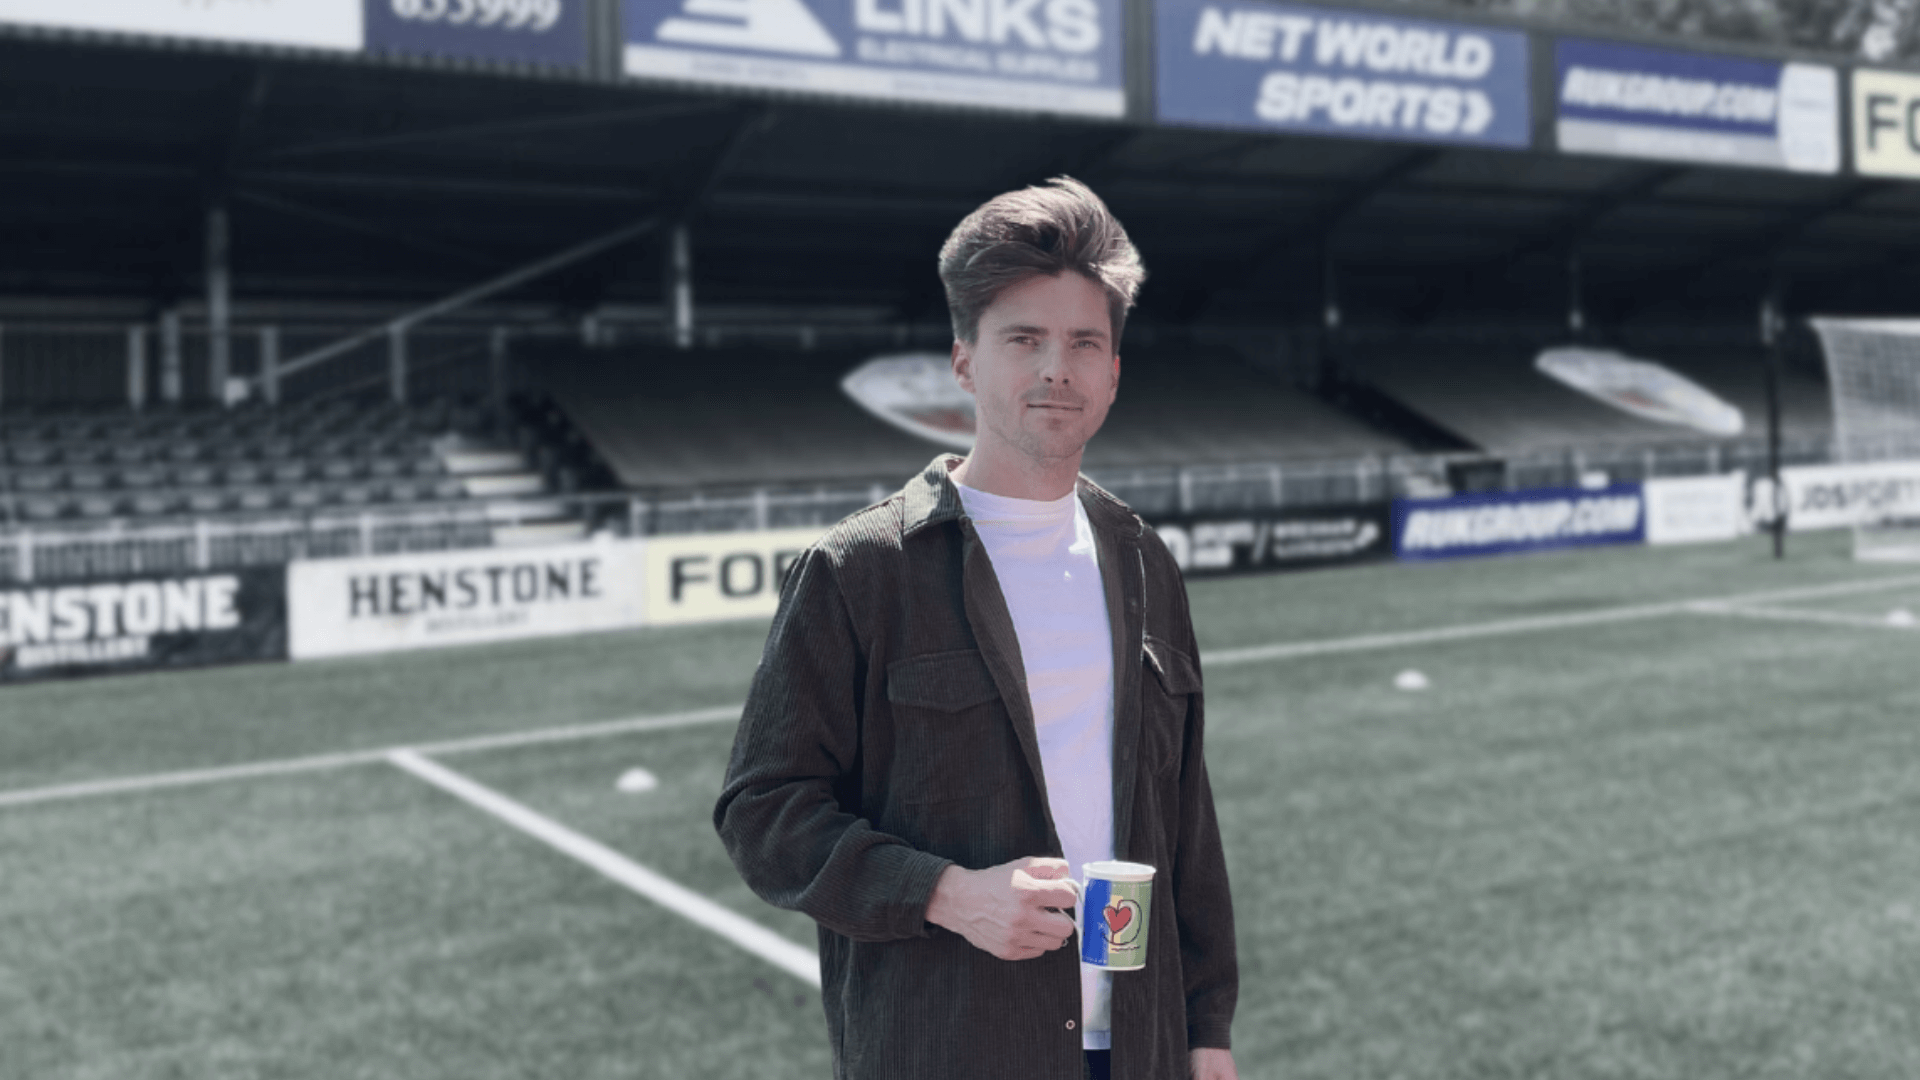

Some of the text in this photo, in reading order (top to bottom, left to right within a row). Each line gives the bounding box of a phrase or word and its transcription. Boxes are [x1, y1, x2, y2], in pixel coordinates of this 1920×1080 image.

[853, 0, 1101, 53] LINKS
[1194, 8, 1494, 79] NET WORLD
[1255, 72, 1460, 132] SPORTS
[0, 574, 240, 645] NSTONE
[349, 558, 604, 618] HENSTONE
